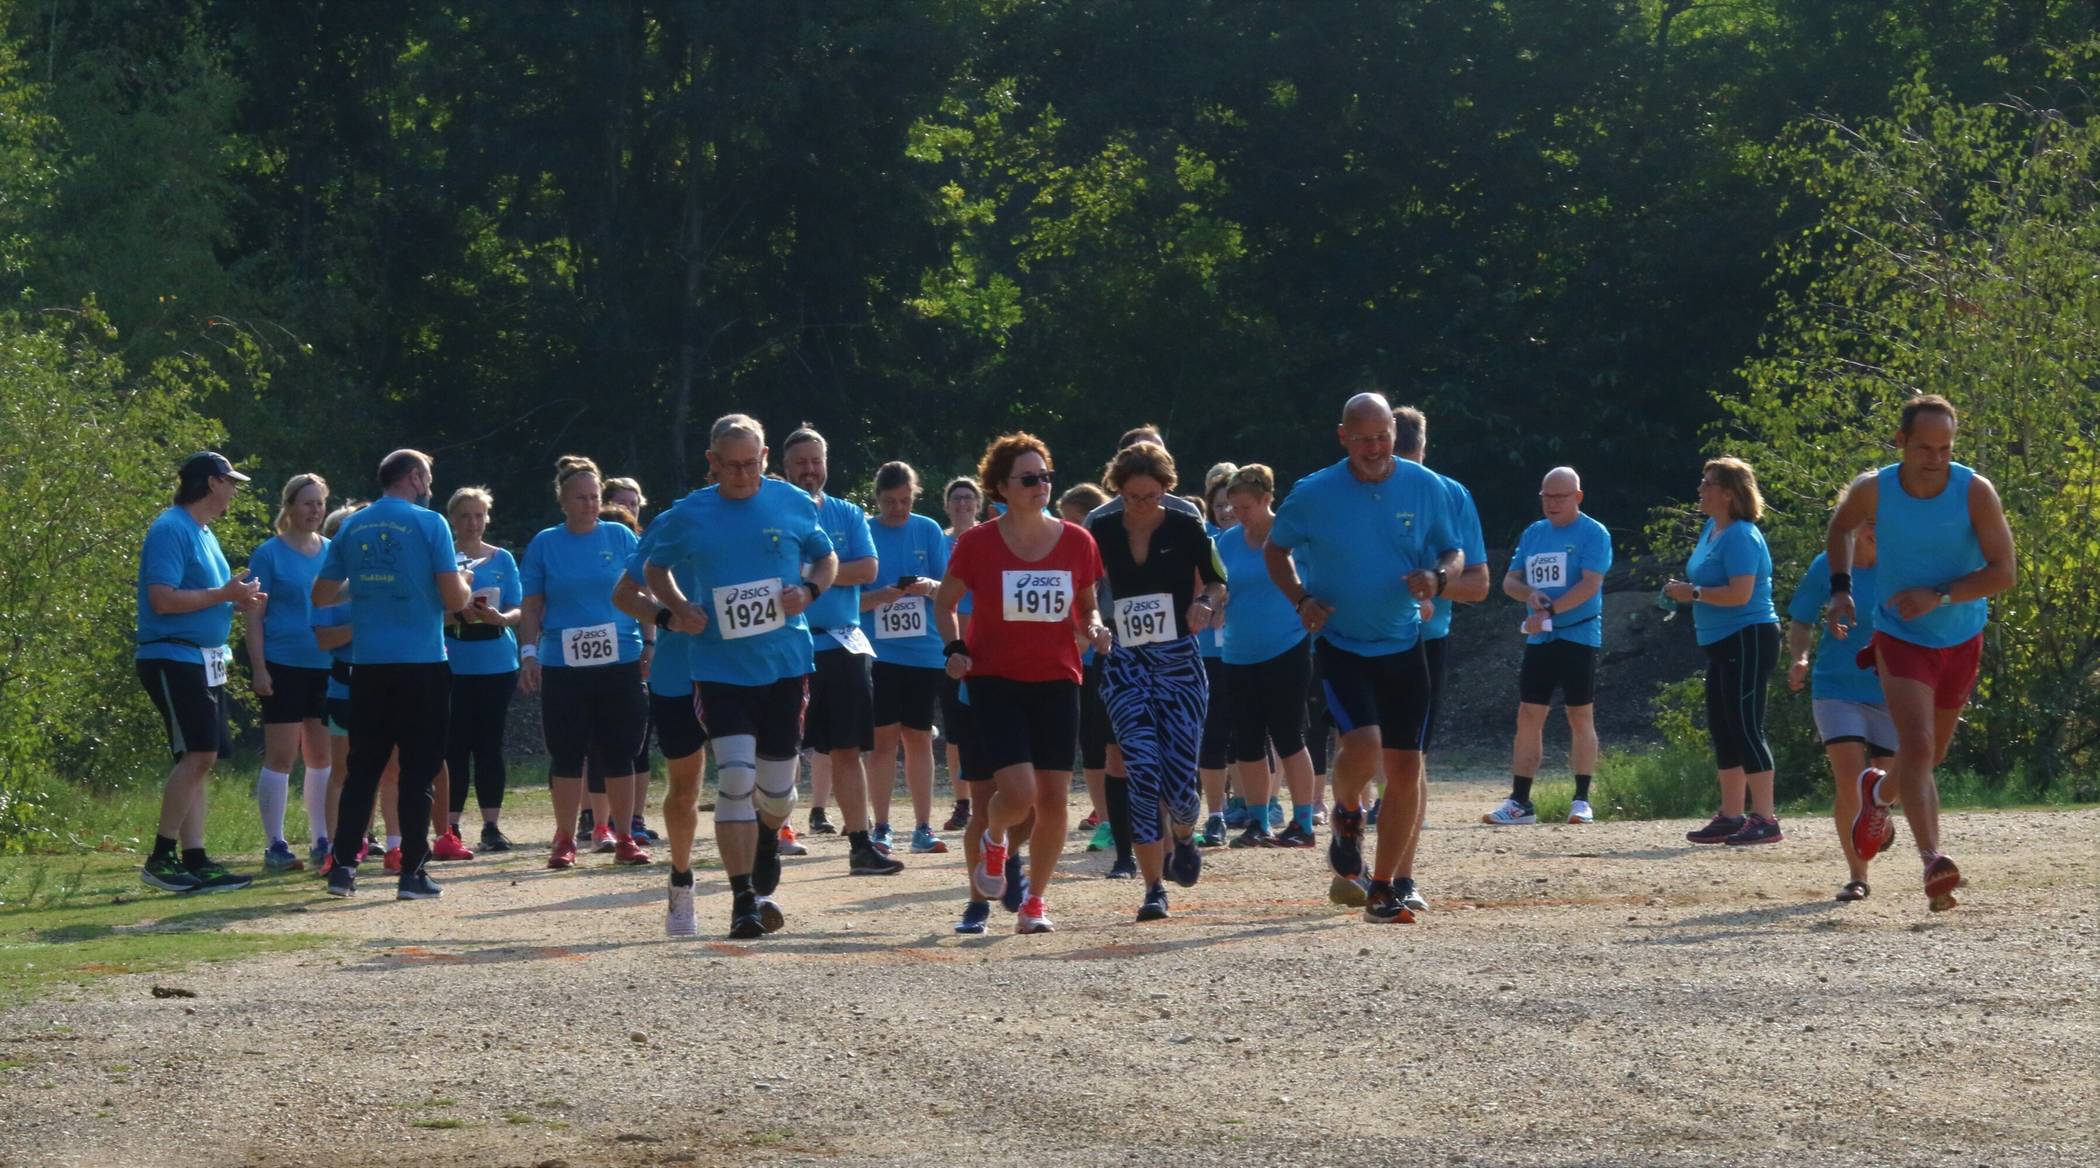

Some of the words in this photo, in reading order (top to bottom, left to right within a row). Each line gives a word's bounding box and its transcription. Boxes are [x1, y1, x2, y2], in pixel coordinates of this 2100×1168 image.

[1032, 576, 1062, 587] asics
[1531, 565, 1559, 584] 1918
[740, 586, 770, 600] asics
[1014, 590, 1065, 614] 1915
[725, 598, 777, 630] 1924
[1133, 600, 1160, 612] asics
[882, 612, 920, 632] 1930
[1123, 611, 1166, 639] 1997
[571, 639, 612, 660] 1926
